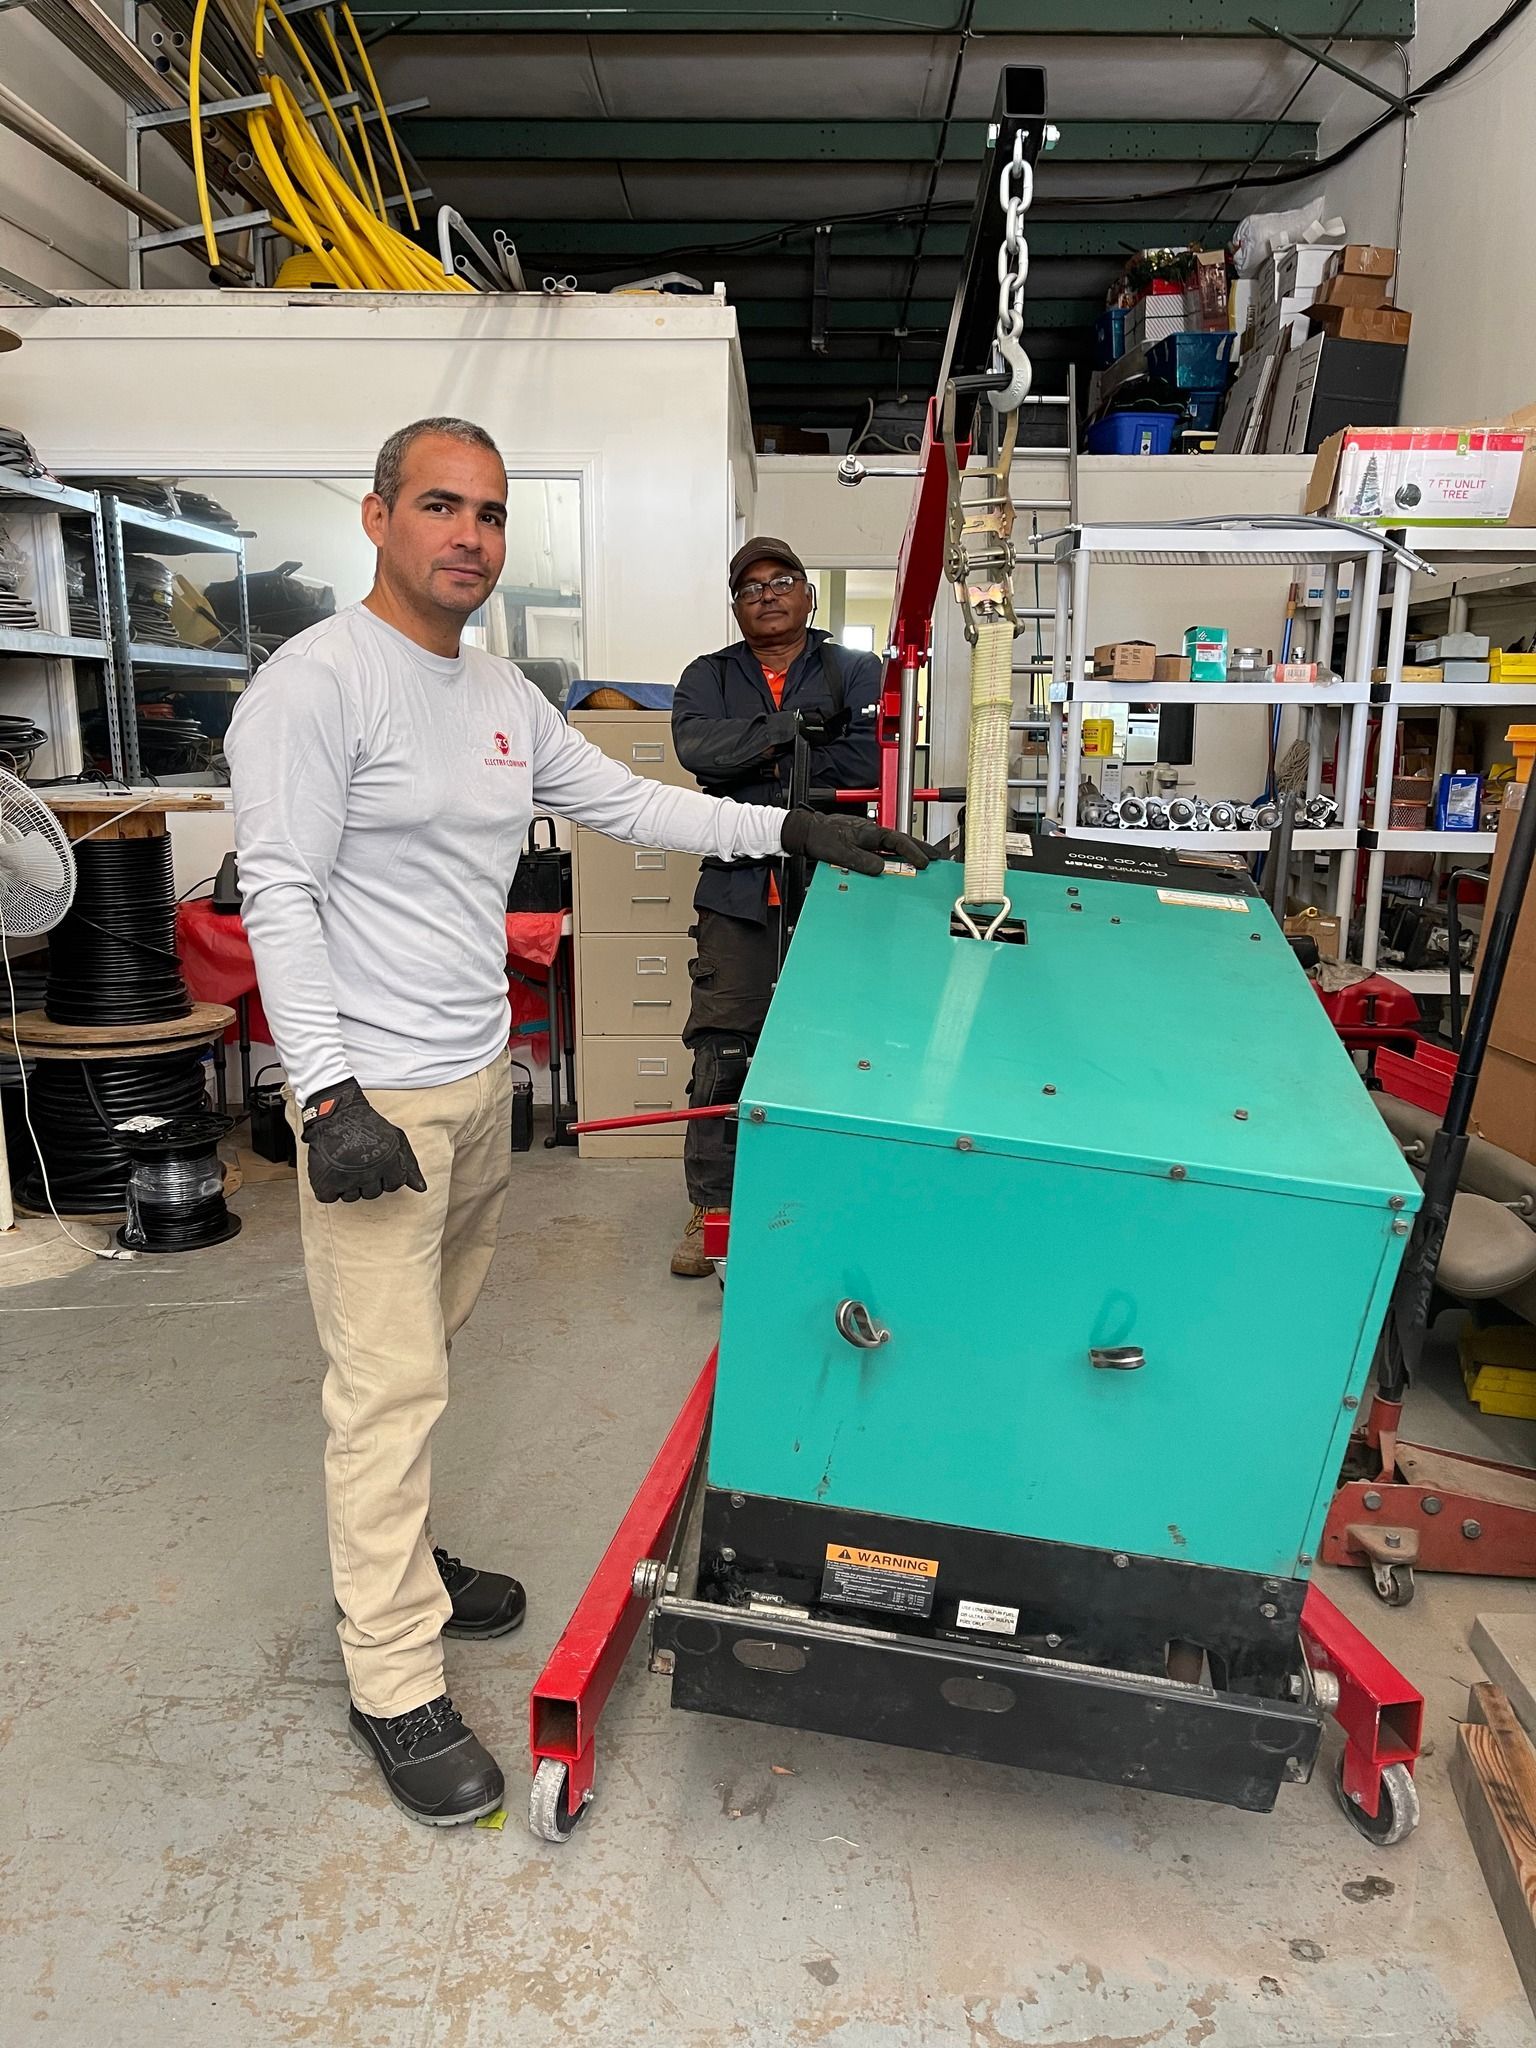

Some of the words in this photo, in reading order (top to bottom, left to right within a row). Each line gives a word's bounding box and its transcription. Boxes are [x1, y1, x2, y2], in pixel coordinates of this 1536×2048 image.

[1429, 479, 1435, 488] 7
[1438, 479, 1451, 488] FT
[1454, 479, 1487, 489] UNLIT
[1443, 489, 1469, 499] TREE
[1068, 853, 1109, 862] 10000
[1065, 860, 1105, 869] Onan
[1107, 865, 1168, 877] Cummins
[858, 1551, 928, 1572] WARNING
